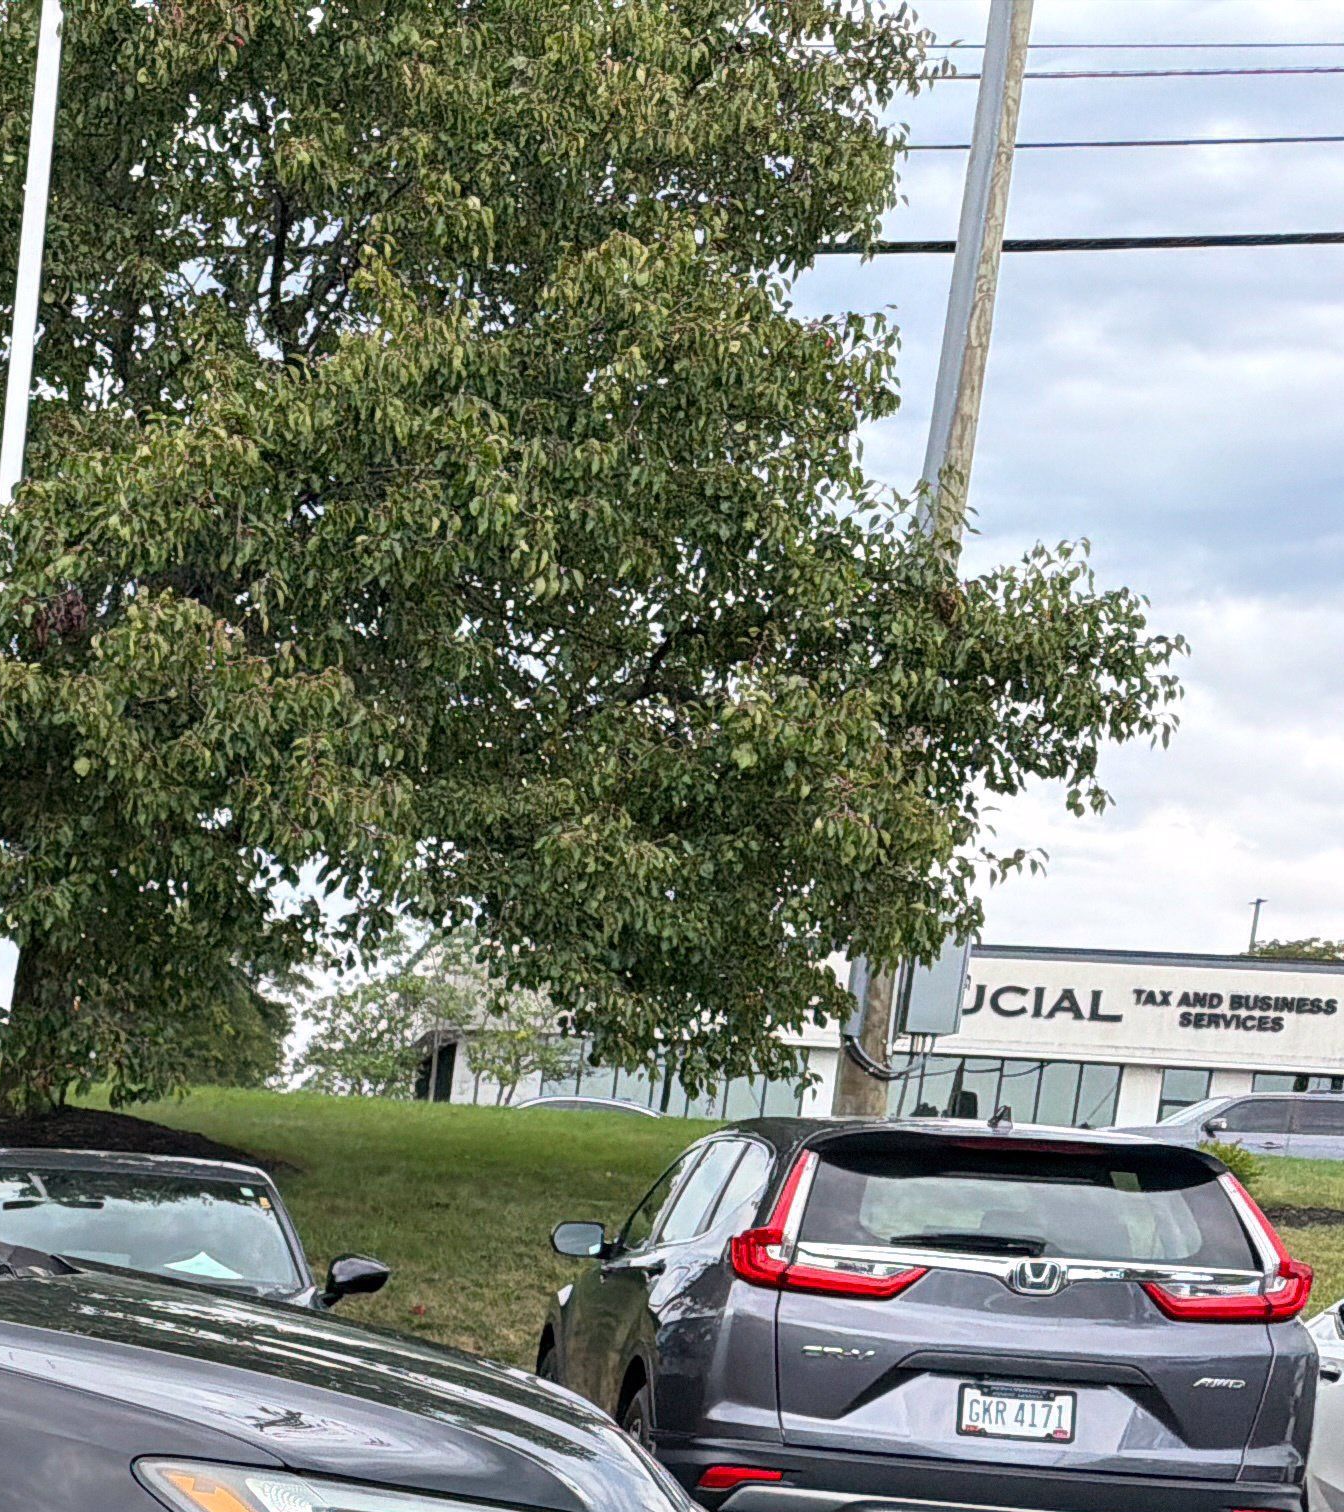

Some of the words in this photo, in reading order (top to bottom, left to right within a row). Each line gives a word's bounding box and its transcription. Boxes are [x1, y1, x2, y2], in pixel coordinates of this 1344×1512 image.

[1132, 988, 1173, 1007] TAX
[1177, 991, 1223, 1009] AND
[1229, 994, 1338, 1015] BUSINESS
[1179, 1011, 1285, 1033] SERVICES
[1193, 1377, 1246, 1389] AWD
[969, 1398, 1006, 1425] GKR
[1014, 1402, 1064, 1429] 4171
